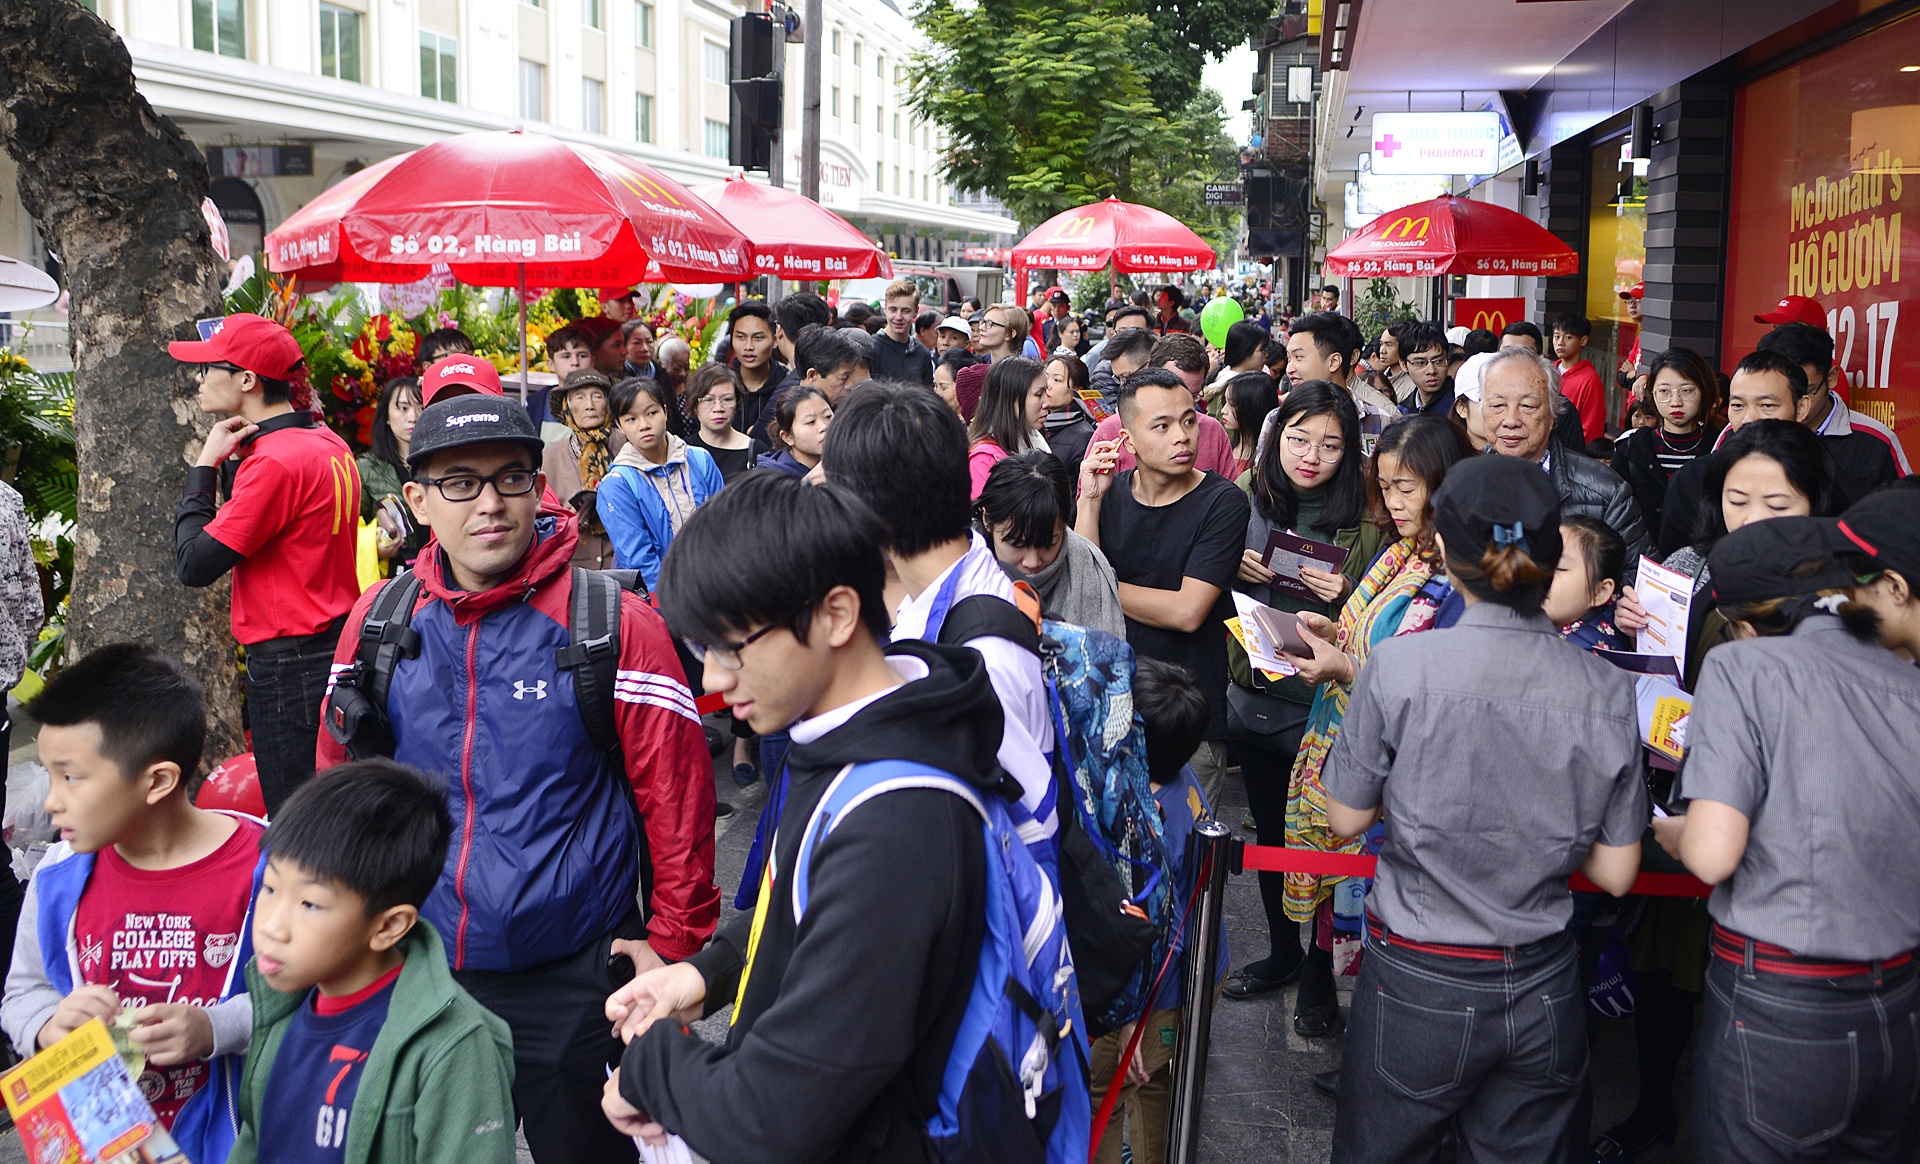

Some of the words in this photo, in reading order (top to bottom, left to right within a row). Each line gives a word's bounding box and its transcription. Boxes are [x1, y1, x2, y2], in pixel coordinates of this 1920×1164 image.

[1419, 148, 1485, 158] PHARMACY
[1206, 184, 1244, 192] CAMER
[1790, 148, 1903, 233] McDonald's
[390, 231, 421, 255] Số
[427, 235, 467, 257] 02,
[474, 235, 536, 257] Hàng
[544, 231, 581, 252] Bài
[652, 234, 666, 255] Số
[668, 240, 688, 262] 02,
[688, 243, 719, 267] Hàng
[720, 248, 739, 266] Bài
[1370, 239, 1426, 248] McDonald's
[756, 255, 780, 271] 02,
[784, 255, 821, 272] Hàng
[825, 256, 847, 271] Bài
[1026, 254, 1038, 265] Số
[1039, 255, 1054, 266] 02,
[1056, 255, 1079, 266] Hàng
[1081, 254, 1097, 264] Bài
[1131, 253, 1142, 264] Số
[1144, 255, 1158, 266] 02,
[1160, 255, 1182, 267] Hàng
[1183, 255, 1198, 266] Bài
[1347, 260, 1361, 272] Số
[1364, 261, 1381, 273] 02,
[1384, 260, 1413, 273] Hàng
[1416, 259, 1435, 271] Bài
[1477, 257, 1491, 269] Số
[1492, 259, 1509, 271] 02,
[1511, 259, 1538, 271] Hàng
[1541, 258, 1557, 270] Bài
[445, 413, 499, 428] Supreme
[113, 930, 196, 949] COLLEGE
[111, 950, 155, 970] PLAY
[159, 950, 196, 968] OFFS
